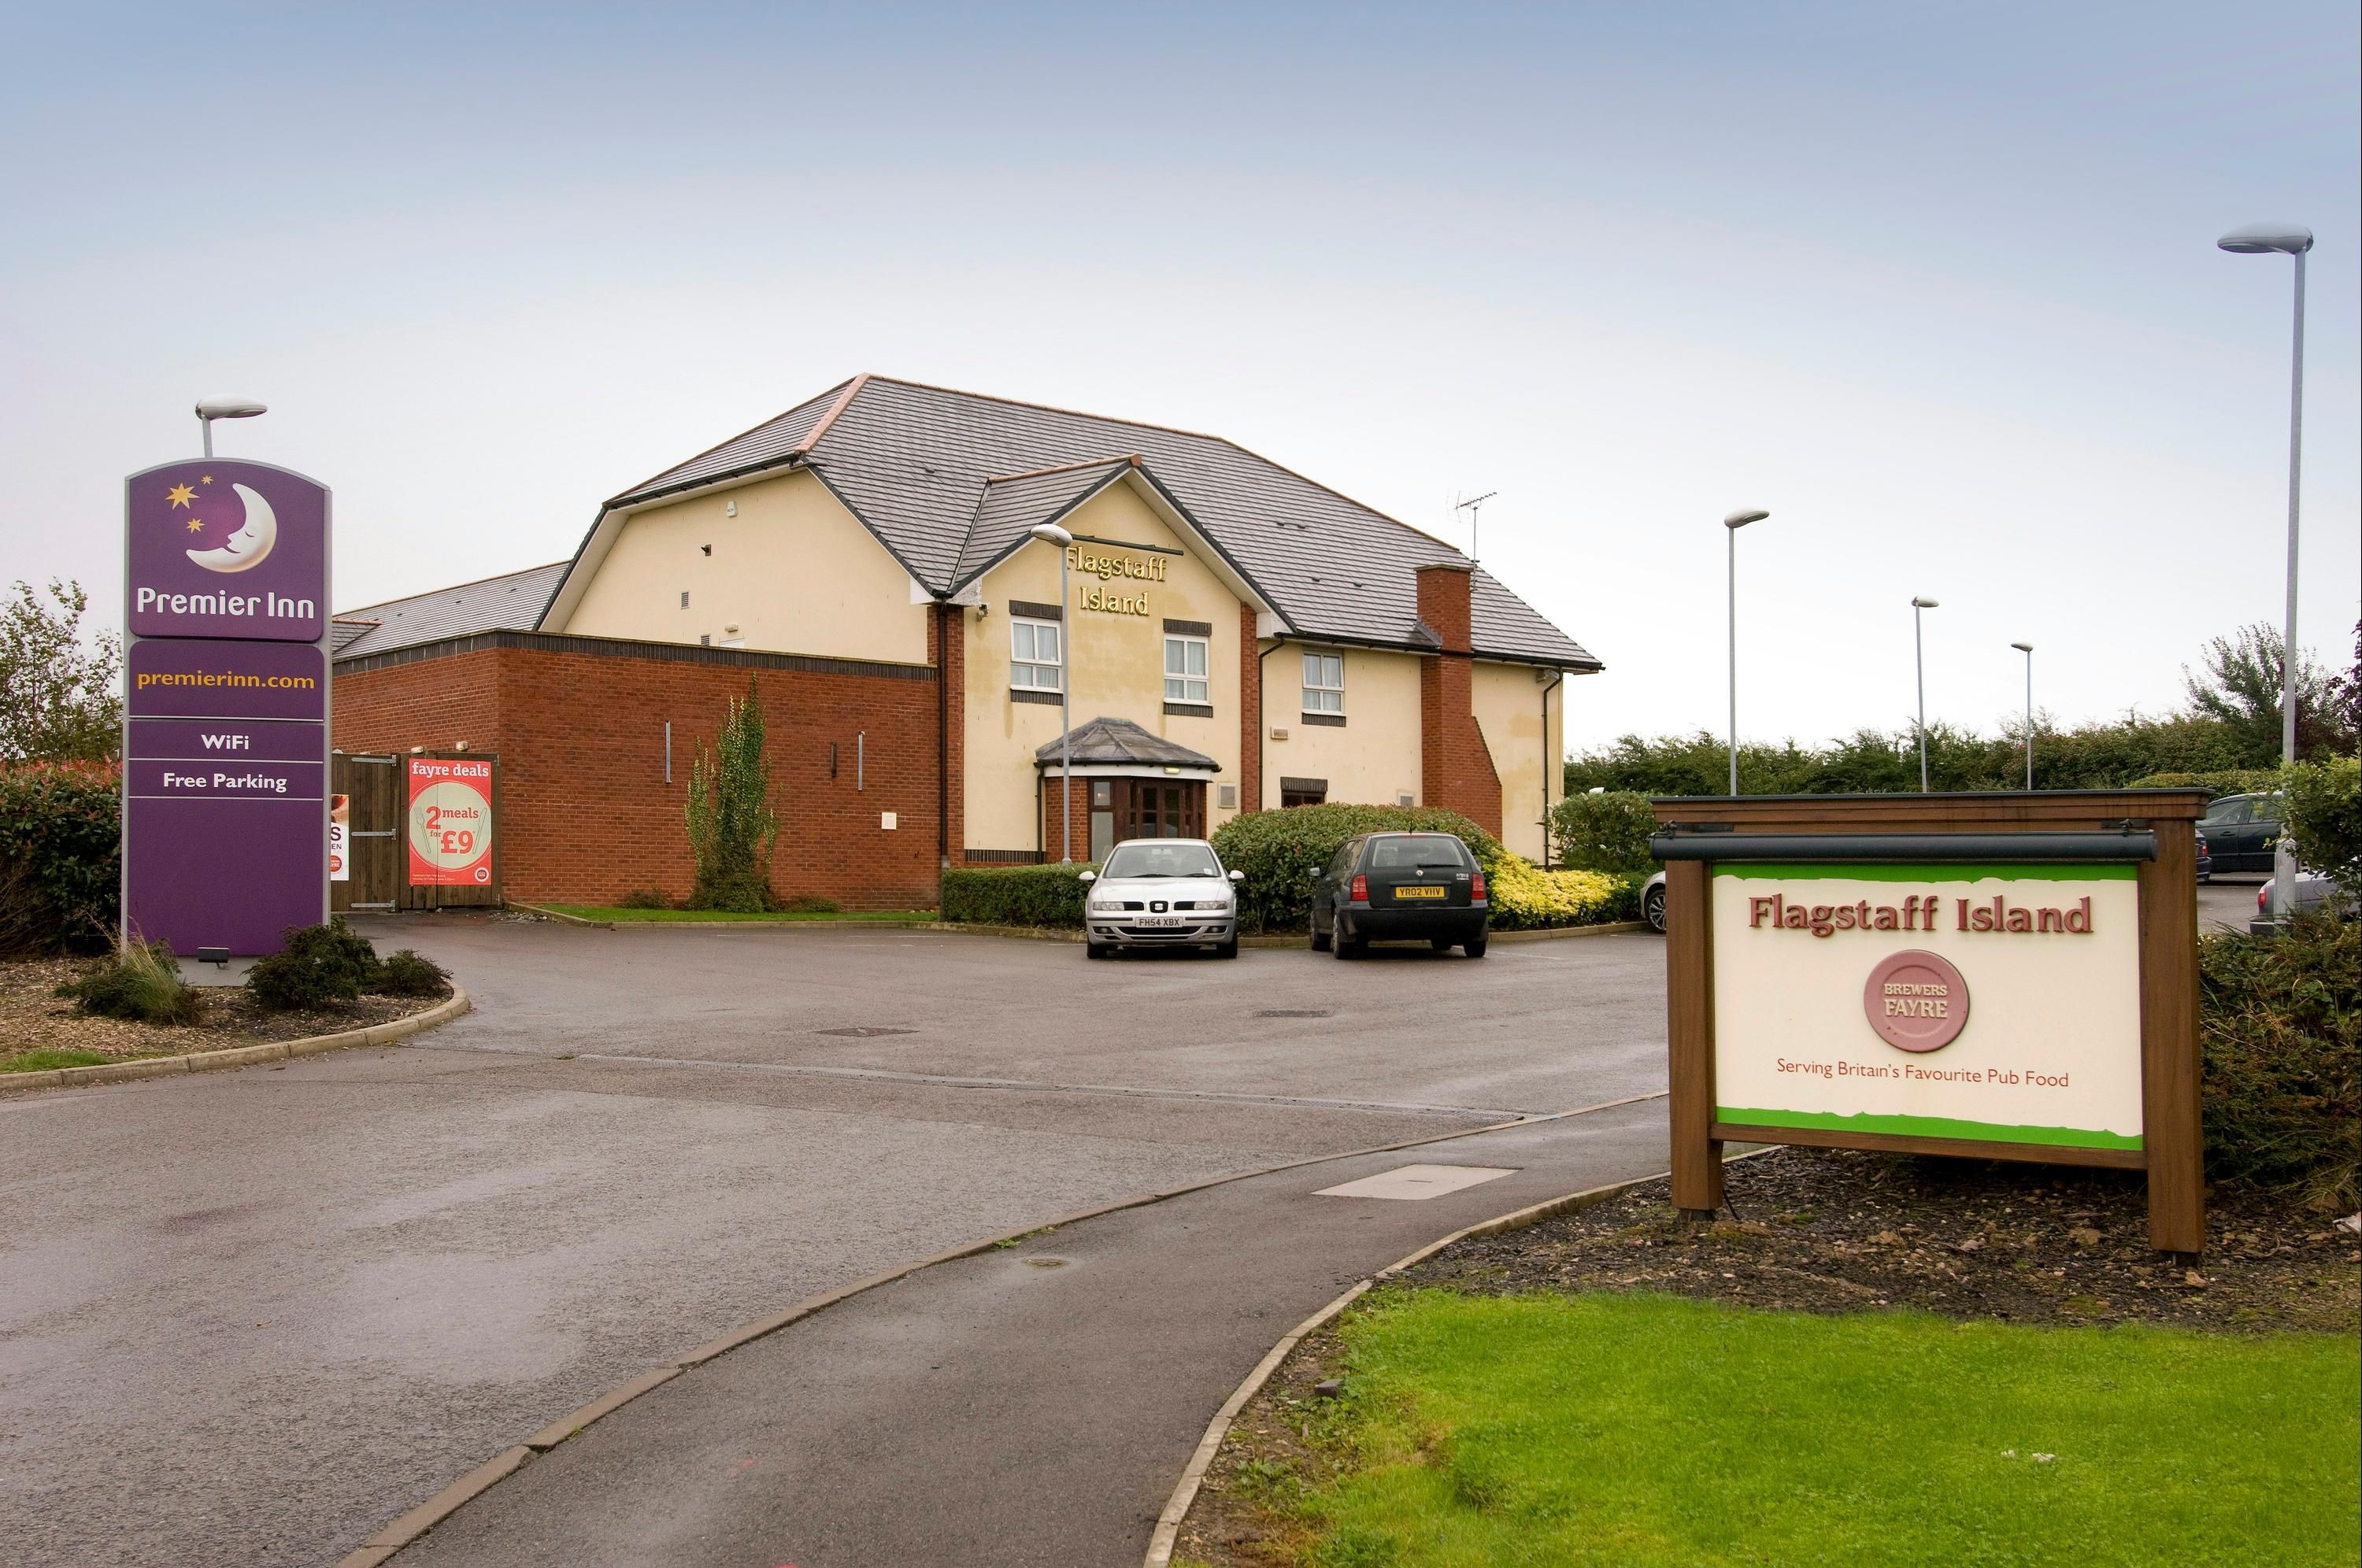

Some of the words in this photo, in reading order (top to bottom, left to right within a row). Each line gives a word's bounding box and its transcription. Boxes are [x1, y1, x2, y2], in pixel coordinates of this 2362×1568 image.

[1067, 546, 1167, 582] Flagstaff
[137, 586, 261, 616] Premier
[268, 592, 314, 619] Inn
[1080, 586, 1150, 616] Island
[138, 670, 315, 690] premierinn.com
[201, 734, 250, 750] WiFi
[412, 761, 450, 778] fayre
[453, 764, 489, 777] deals
[163, 772, 207, 788] Free
[213, 773, 287, 793] Parking
[426, 806, 441, 829] 2
[442, 807, 479, 819] meals
[331, 827, 341, 841] S
[1748, 893, 1938, 937] Flagstaff
[1956, 895, 2094, 934] Island
[1884, 983, 1947, 997] BREWERS
[1884, 999, 1948, 1019] FAYRE
[1777, 1058, 1833, 1079] Serving
[1838, 1061, 1900, 1078] Britain's
[1905, 1064, 1983, 1083] Favourite
[1988, 1069, 2020, 1085] Pub
[2026, 1071, 2069, 1087] Food
